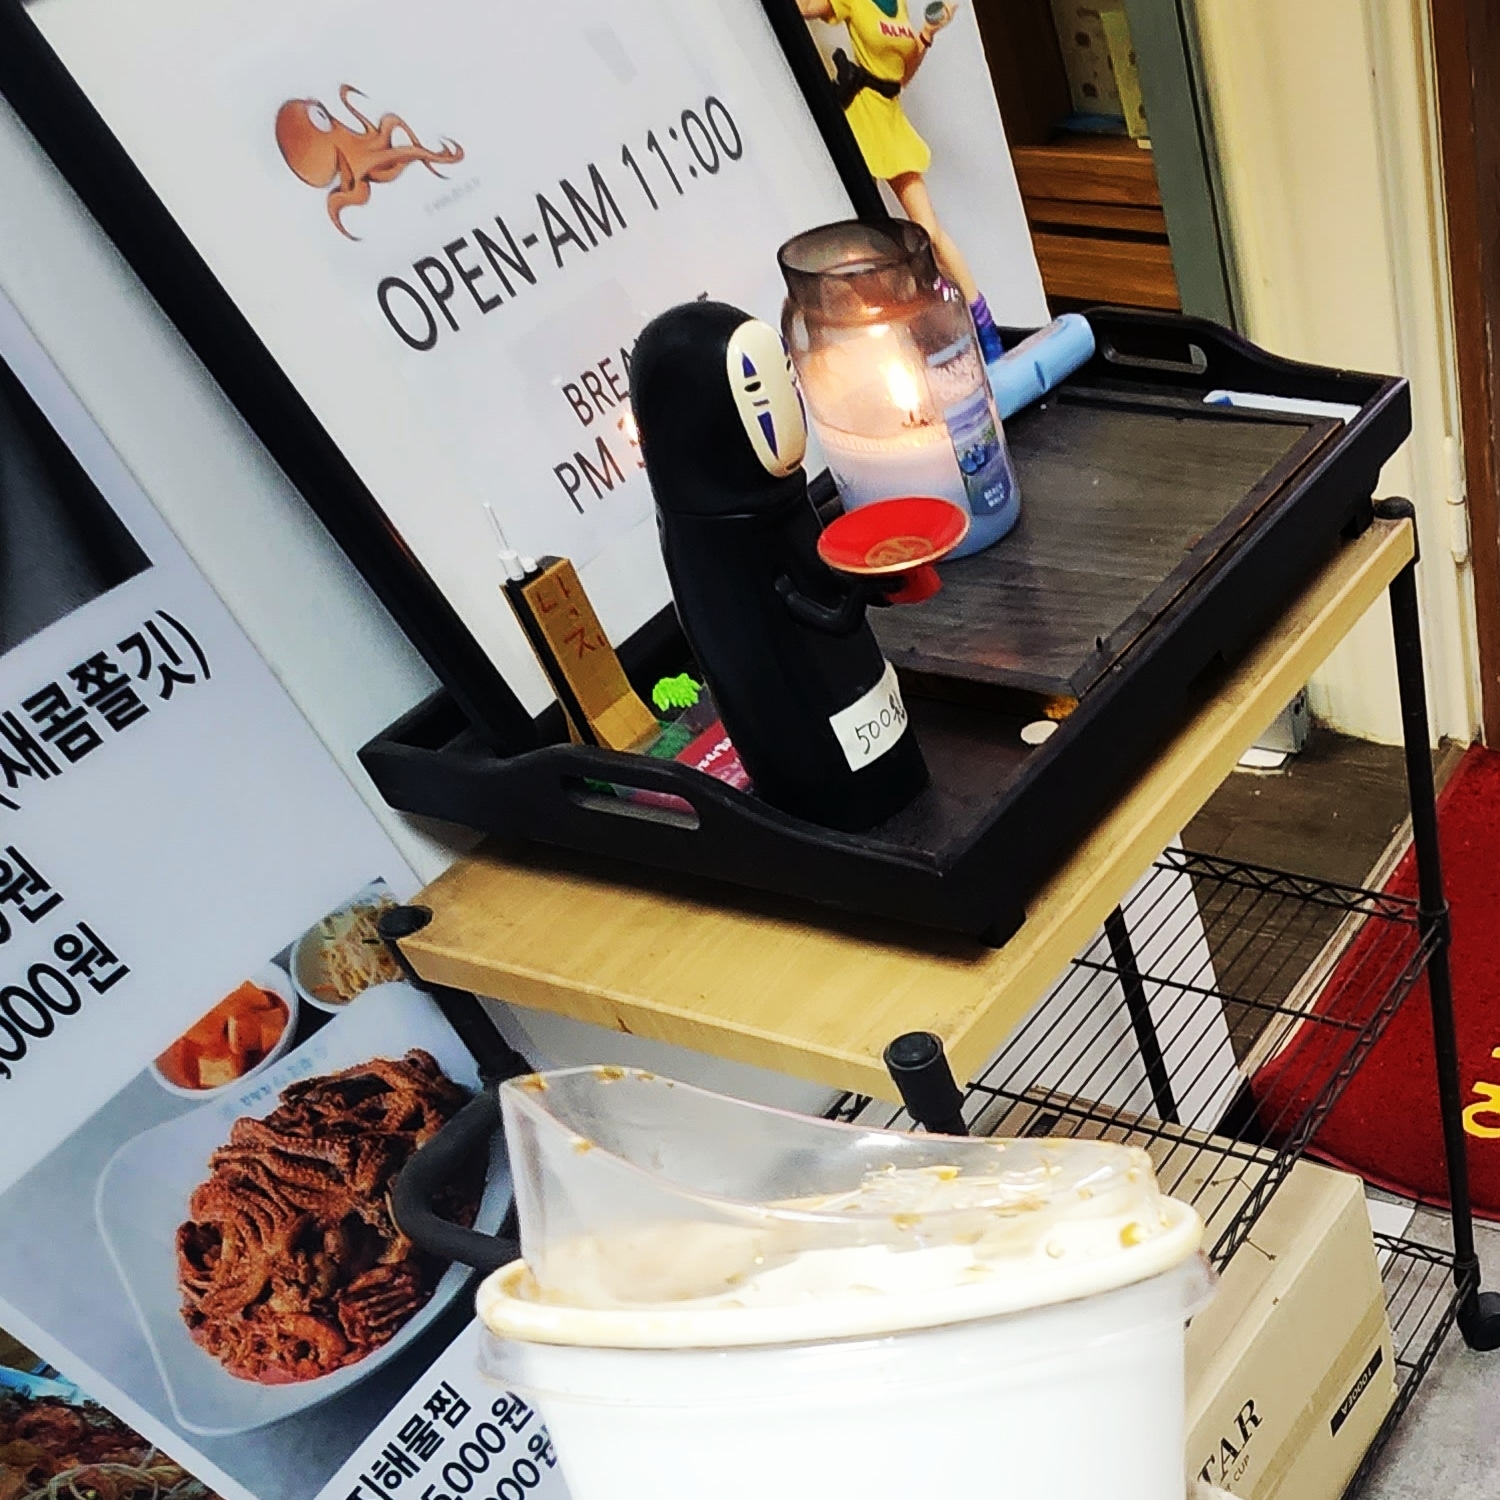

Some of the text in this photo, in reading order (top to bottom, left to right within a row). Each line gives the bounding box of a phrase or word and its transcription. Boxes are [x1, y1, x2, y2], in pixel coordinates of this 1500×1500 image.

[376, 95, 743, 351] OPEN-AM 11:00
[552, 435, 626, 515] PM
